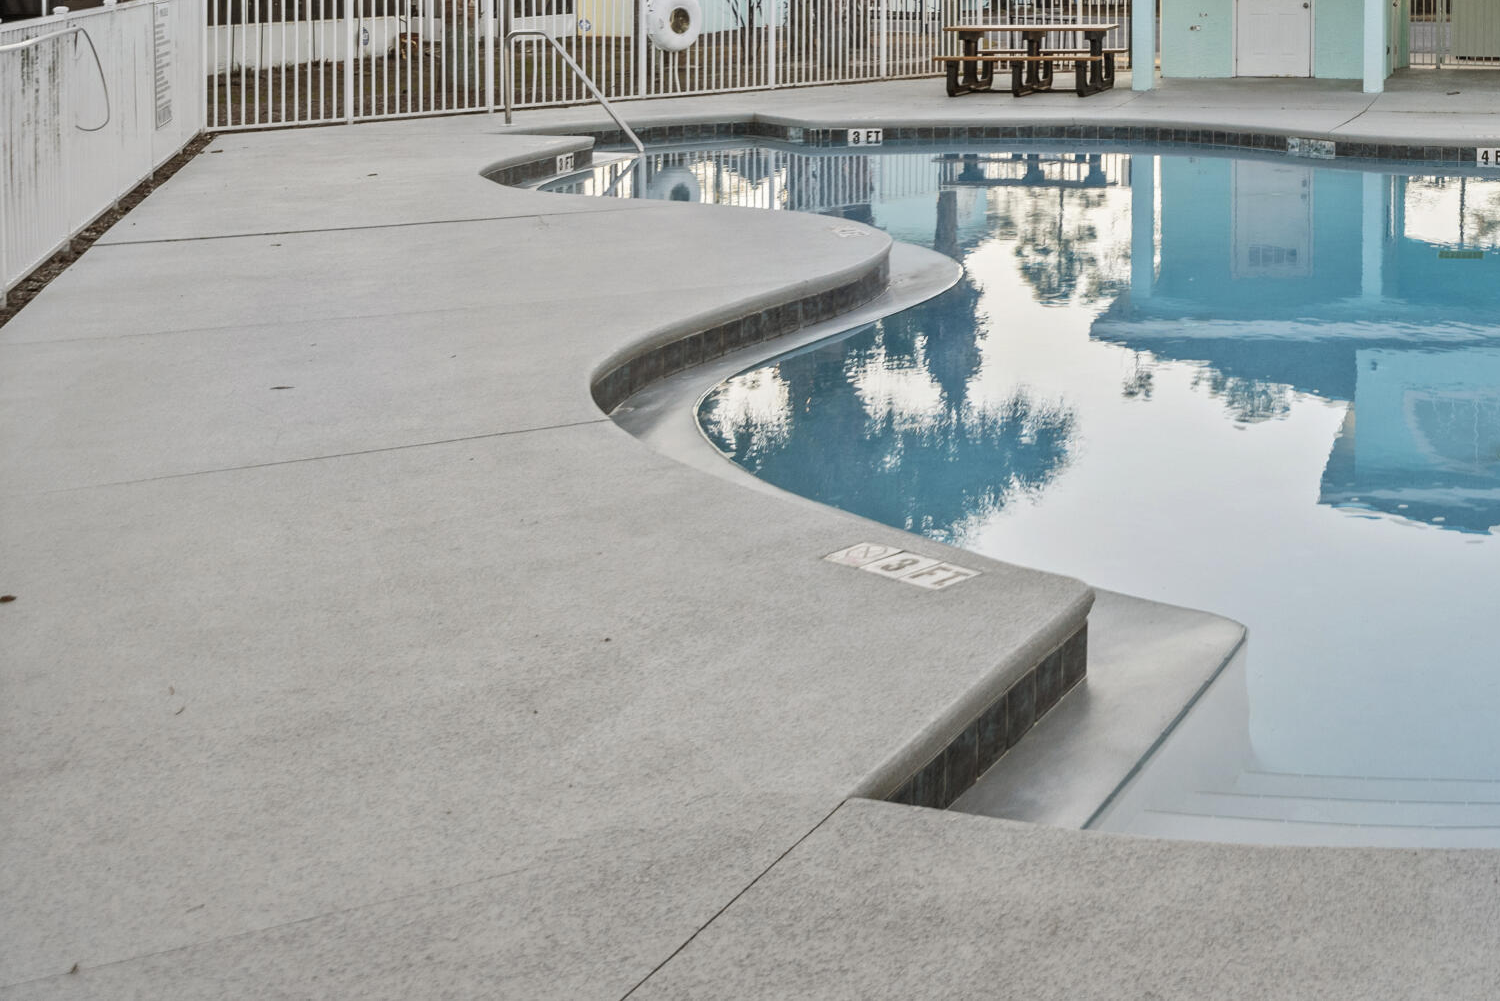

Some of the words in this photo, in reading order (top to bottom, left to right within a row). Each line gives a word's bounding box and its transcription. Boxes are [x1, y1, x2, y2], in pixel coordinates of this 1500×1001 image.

[852, 130, 861, 145] 3
[1481, 150, 1490, 166] 4
[880, 558, 920, 572] 3
